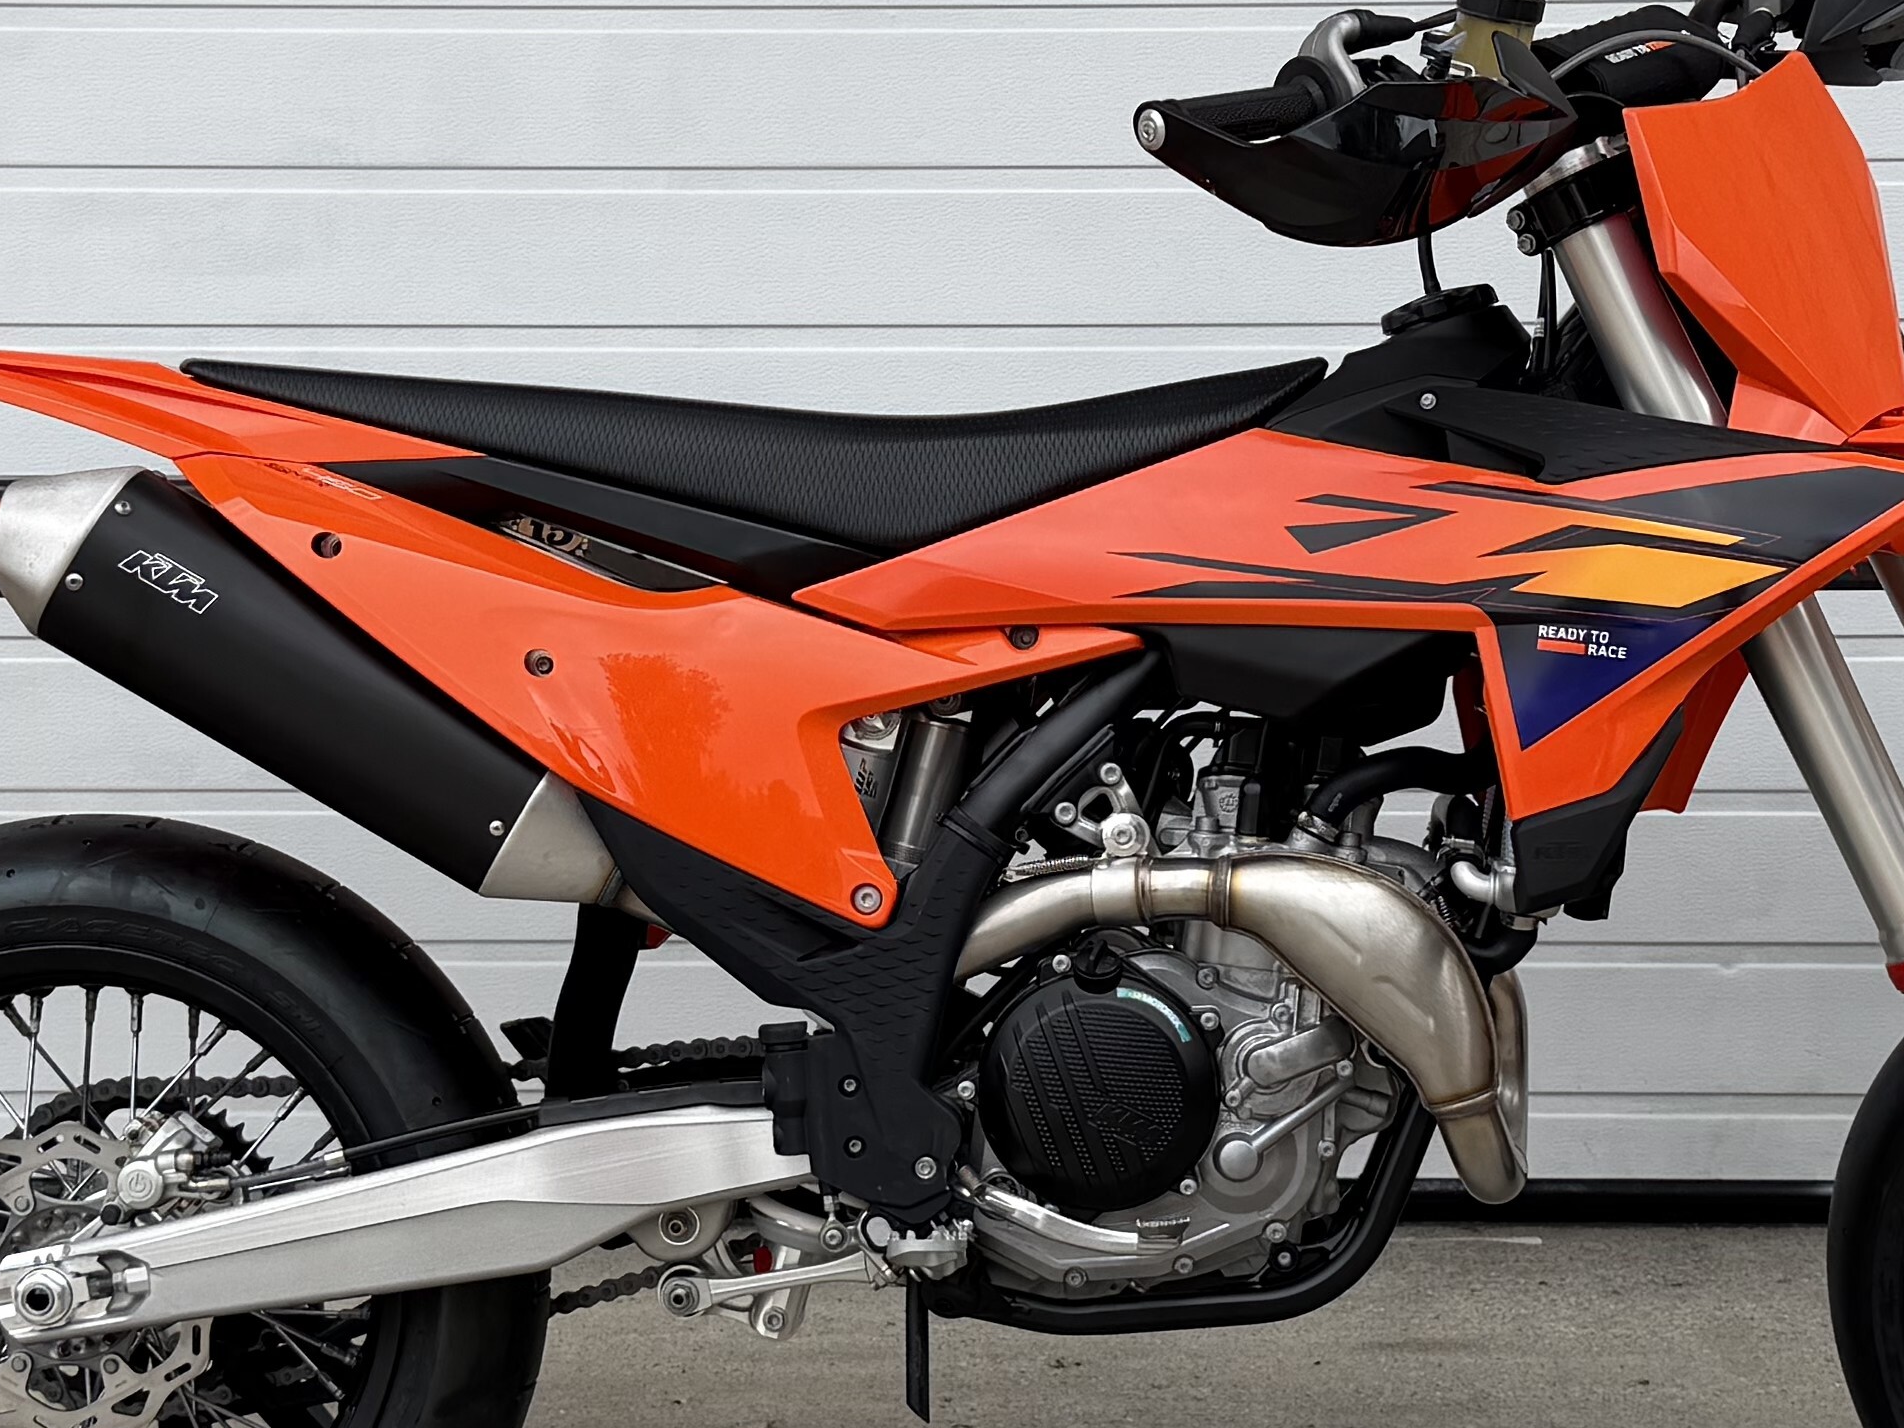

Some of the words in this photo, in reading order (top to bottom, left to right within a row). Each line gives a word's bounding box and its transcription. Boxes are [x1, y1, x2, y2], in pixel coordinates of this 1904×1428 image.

[117, 549, 219, 615] KTM
[1538, 624, 1588, 642] READY
[1590, 630, 1610, 644] TO
[1587, 643, 1628, 659] RACE
